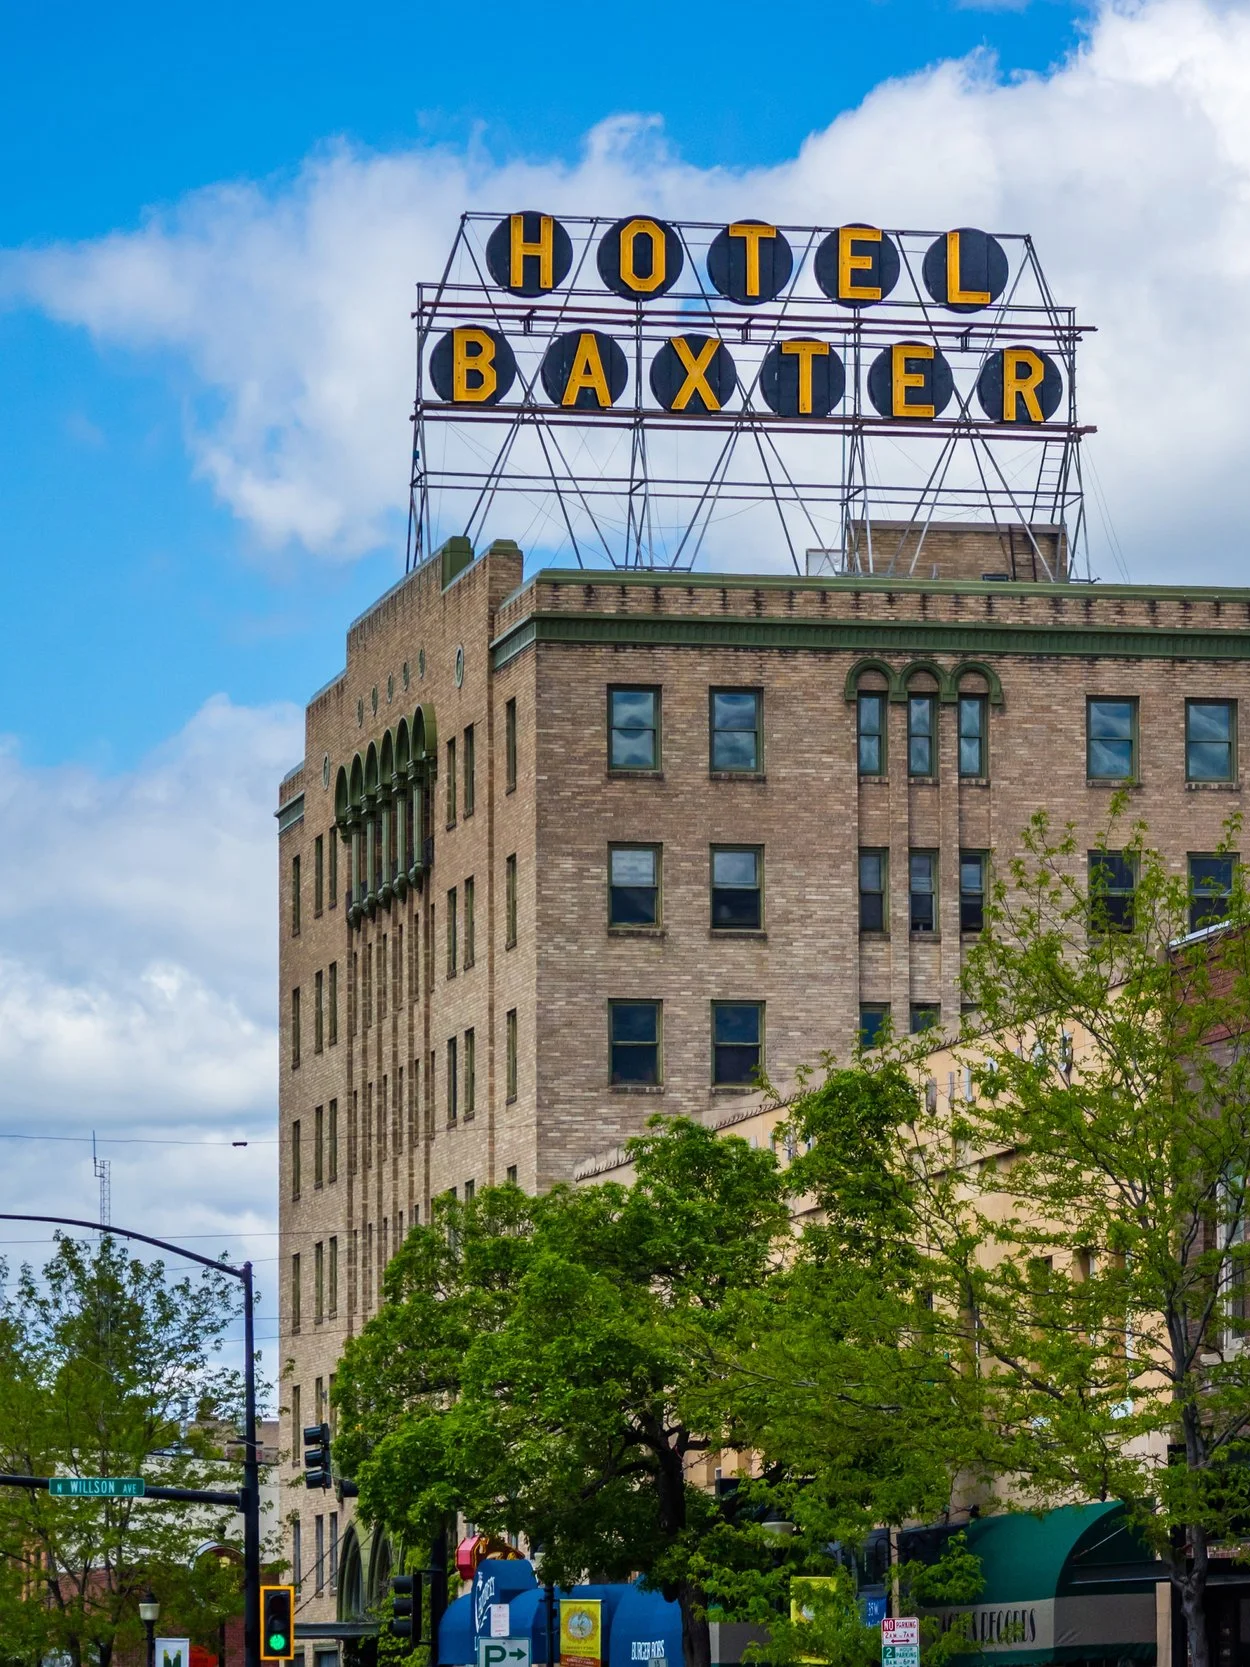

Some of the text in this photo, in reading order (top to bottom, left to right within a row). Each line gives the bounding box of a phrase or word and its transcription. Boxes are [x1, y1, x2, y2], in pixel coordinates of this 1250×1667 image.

[510, 214, 991, 304] HOTEL
[453, 328, 1046, 422] BAXTER
[57, 1480, 137, 1494] N WILLSON AVE
[884, 1620, 894, 1631] NO
[896, 1621, 916, 1629] PARKING
[885, 1647, 892, 1658] 2
